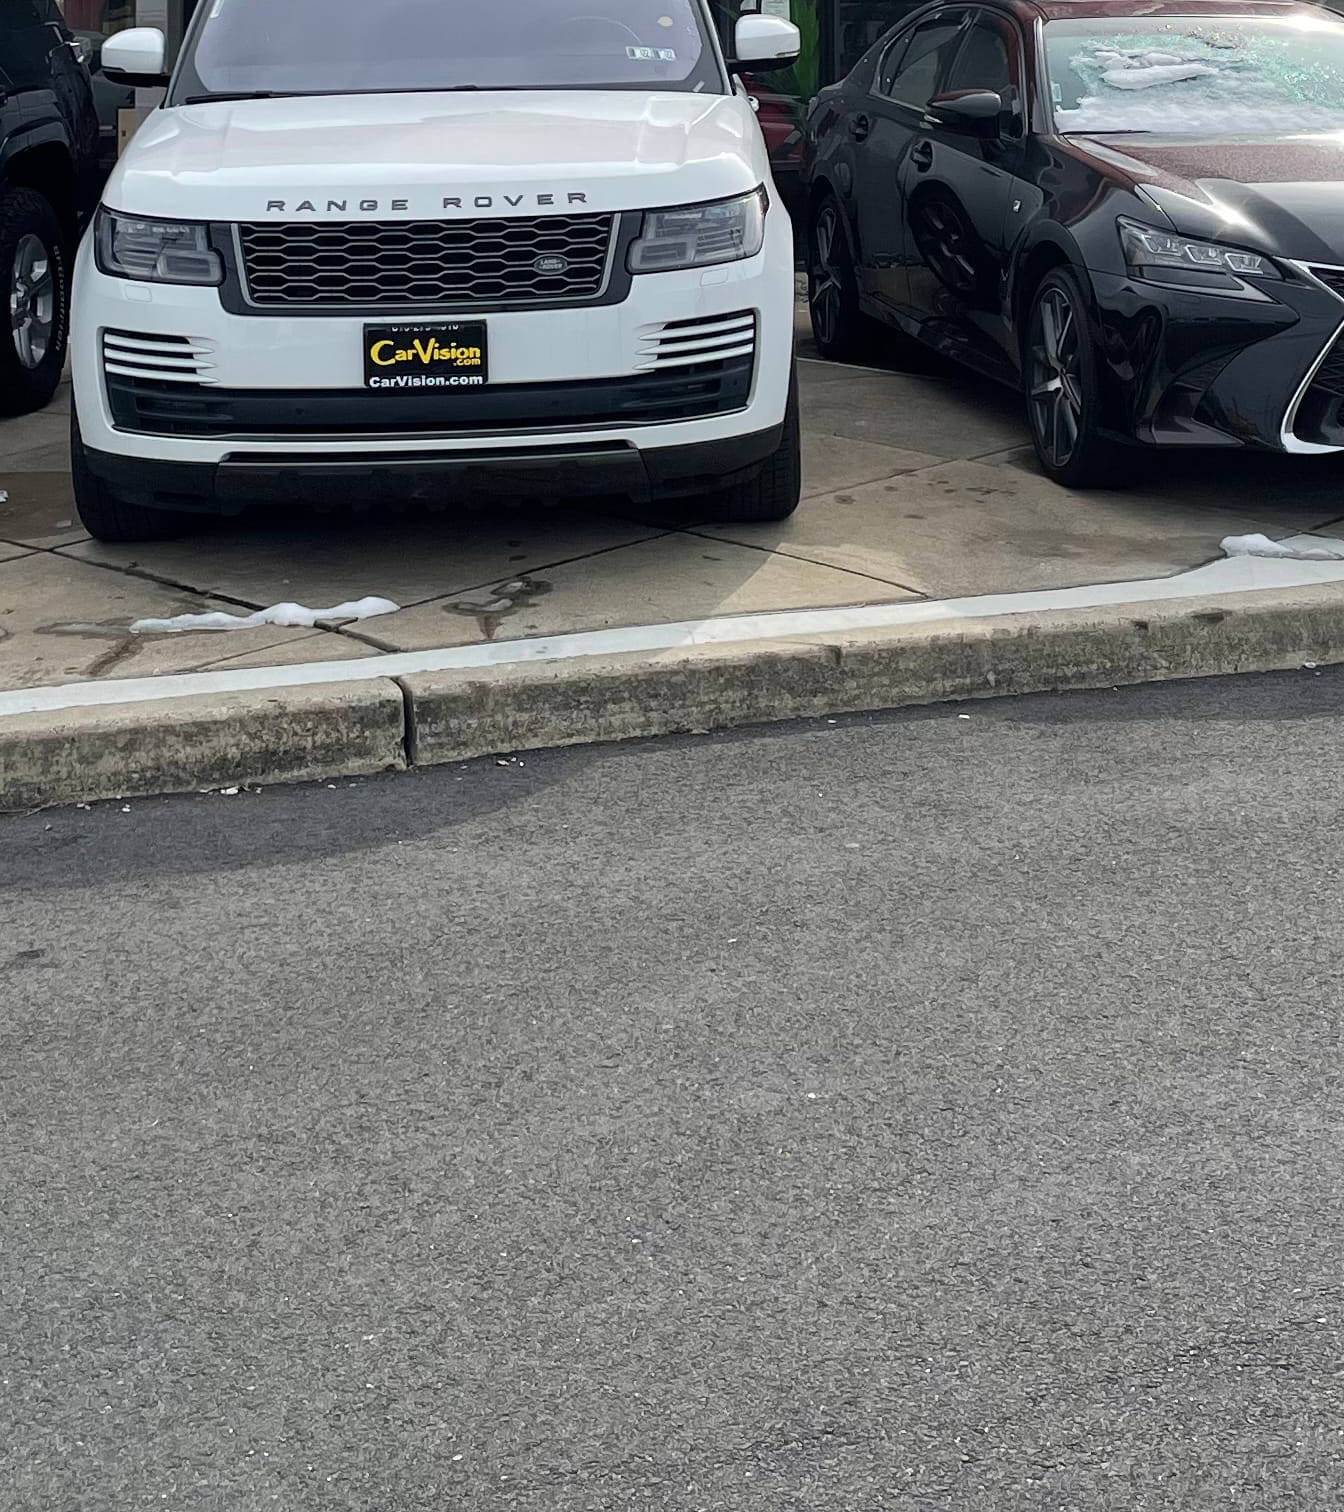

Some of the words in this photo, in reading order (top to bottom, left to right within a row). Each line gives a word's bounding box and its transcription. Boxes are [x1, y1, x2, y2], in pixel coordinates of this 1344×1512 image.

[265, 199, 409, 212] RANGE
[442, 191, 588, 209] ROVER
[370, 337, 482, 366] CarVision
[452, 357, 482, 367] .com
[369, 375, 484, 388] CarVision.com
